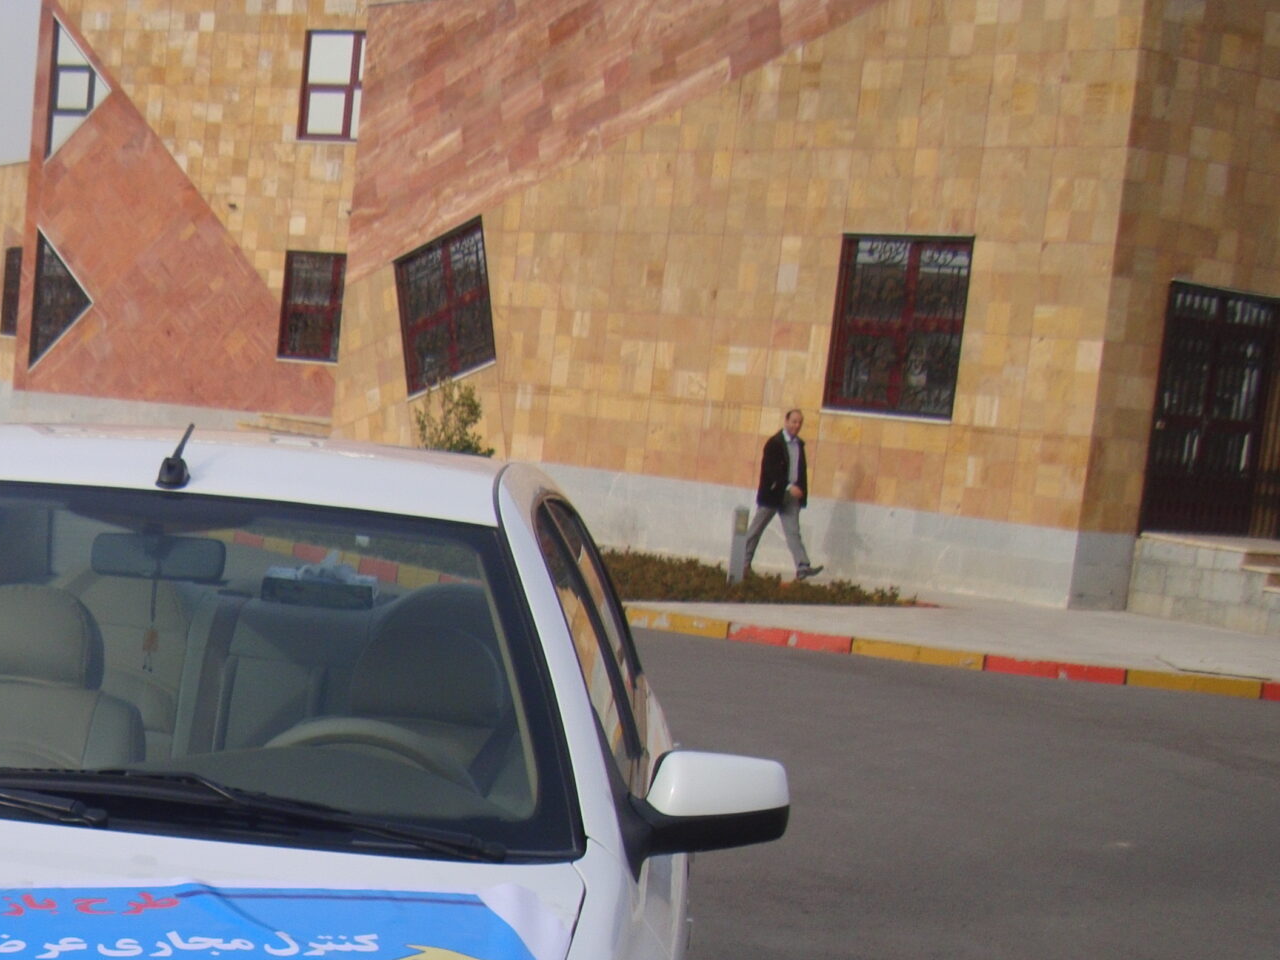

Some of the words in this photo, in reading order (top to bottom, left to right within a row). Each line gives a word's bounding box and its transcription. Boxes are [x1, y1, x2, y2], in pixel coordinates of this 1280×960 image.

[72, 892, 181, 916] طرح
[97, 931, 256, 957] مجاری
[263, 930, 380, 957] کنترل
